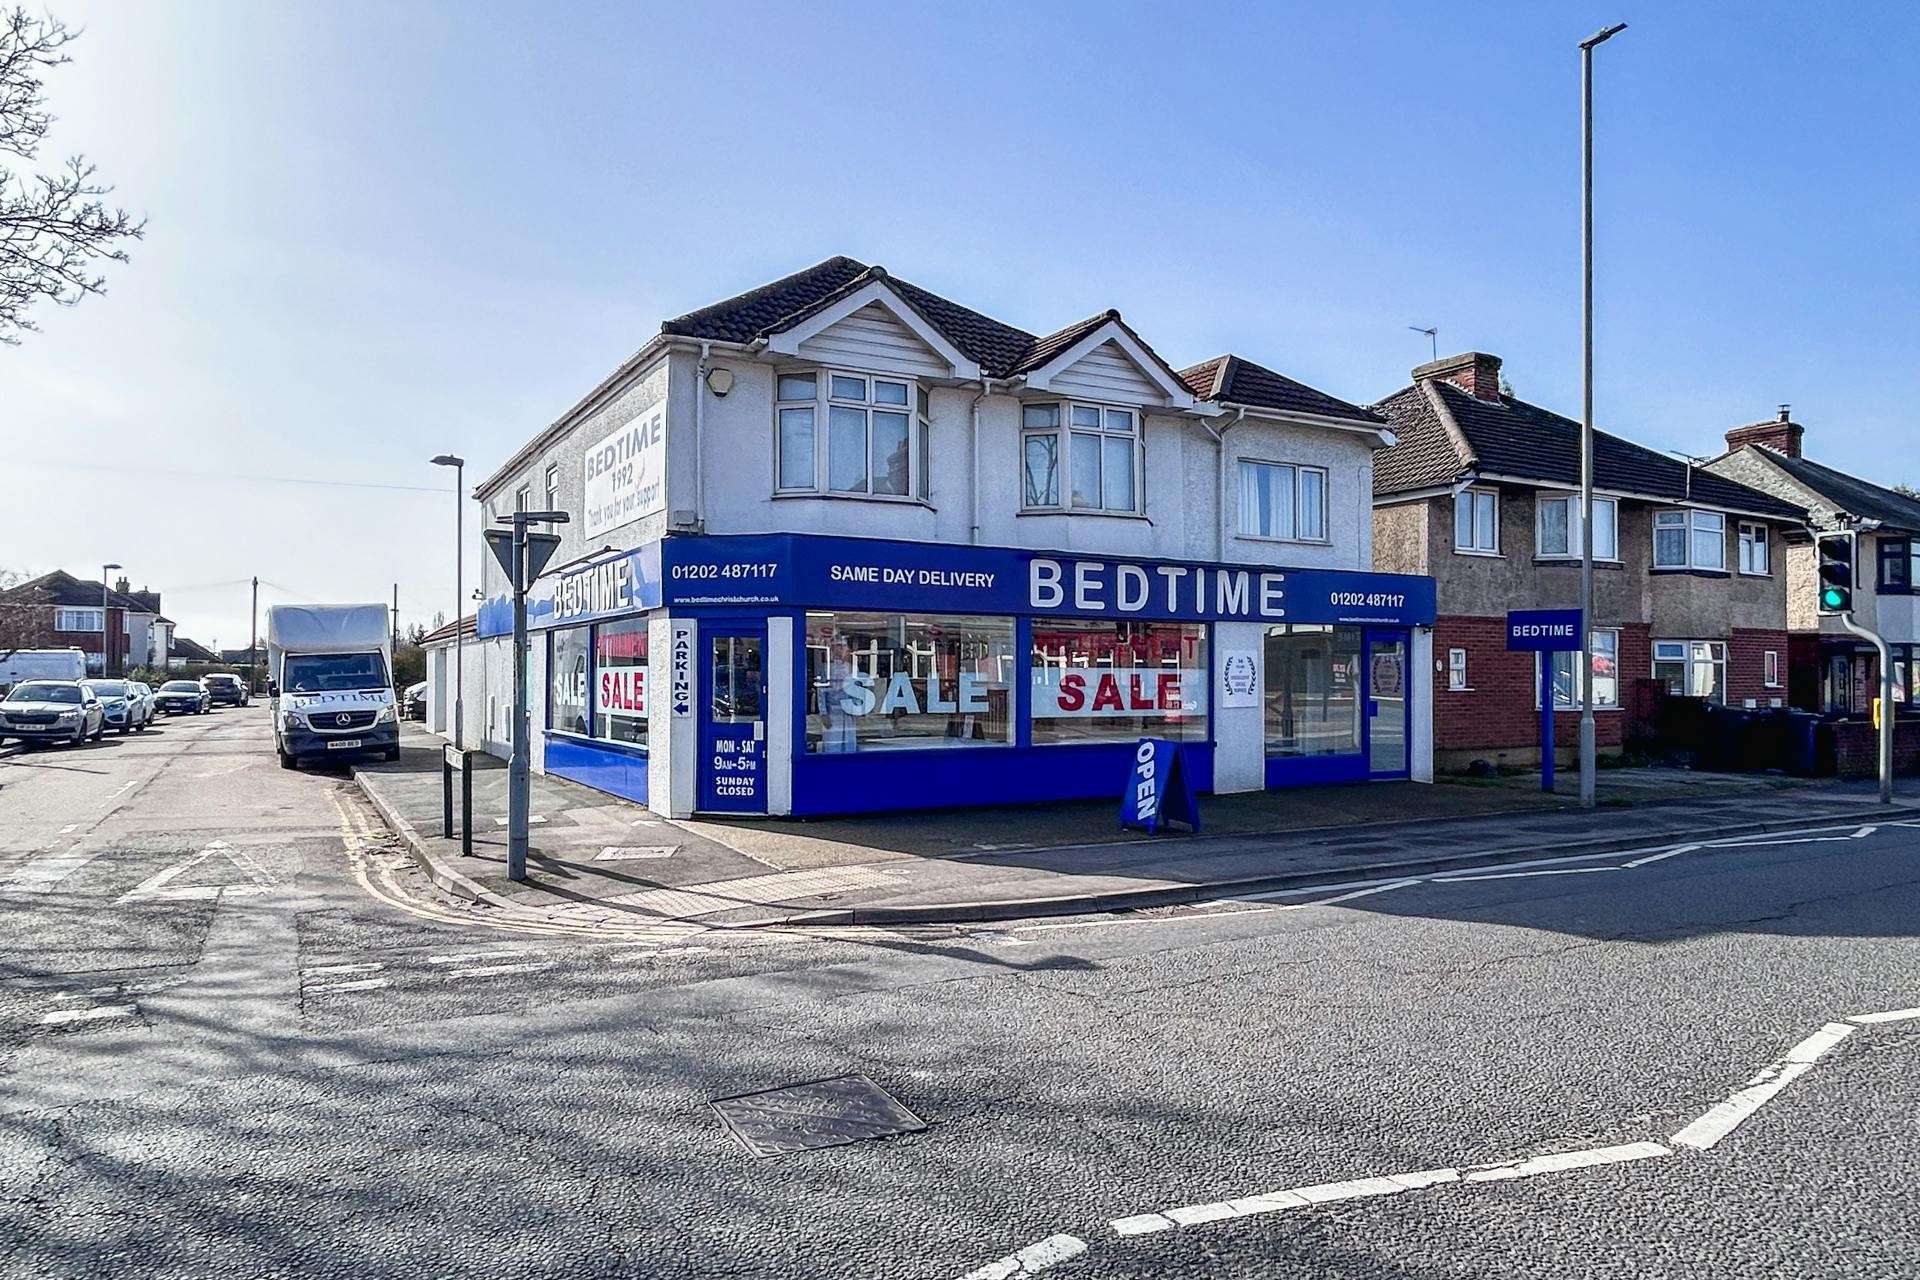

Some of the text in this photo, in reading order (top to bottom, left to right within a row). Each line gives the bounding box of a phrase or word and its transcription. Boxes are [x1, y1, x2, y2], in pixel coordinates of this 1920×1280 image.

[587, 413, 661, 482] BEDTIME
[611, 463, 633, 493] 1992
[672, 563, 778, 579] 01202 487117
[830, 565, 995, 588] SAME DAY DELIVERY
[554, 558, 630, 620] BEDTIME
[1029, 558, 1286, 617] BEDTIME
[1330, 592, 1405, 607] 01202 487117
[1512, 624, 1574, 637] BEDTIME
[674, 630, 690, 701] PARKING
[293, 693, 389, 710] BEDTIME
[554, 672, 586, 707] SALE
[601, 672, 644, 711] SALE
[841, 671, 990, 716] SALE
[1057, 673, 1182, 711] SALE
[715, 740, 735, 753] MON
[741, 740, 756, 753] SAT
[715, 776, 755, 786] SUNDAY
[716, 786, 754, 796] CLOSED
[1136, 741, 1156, 821] OPEN
